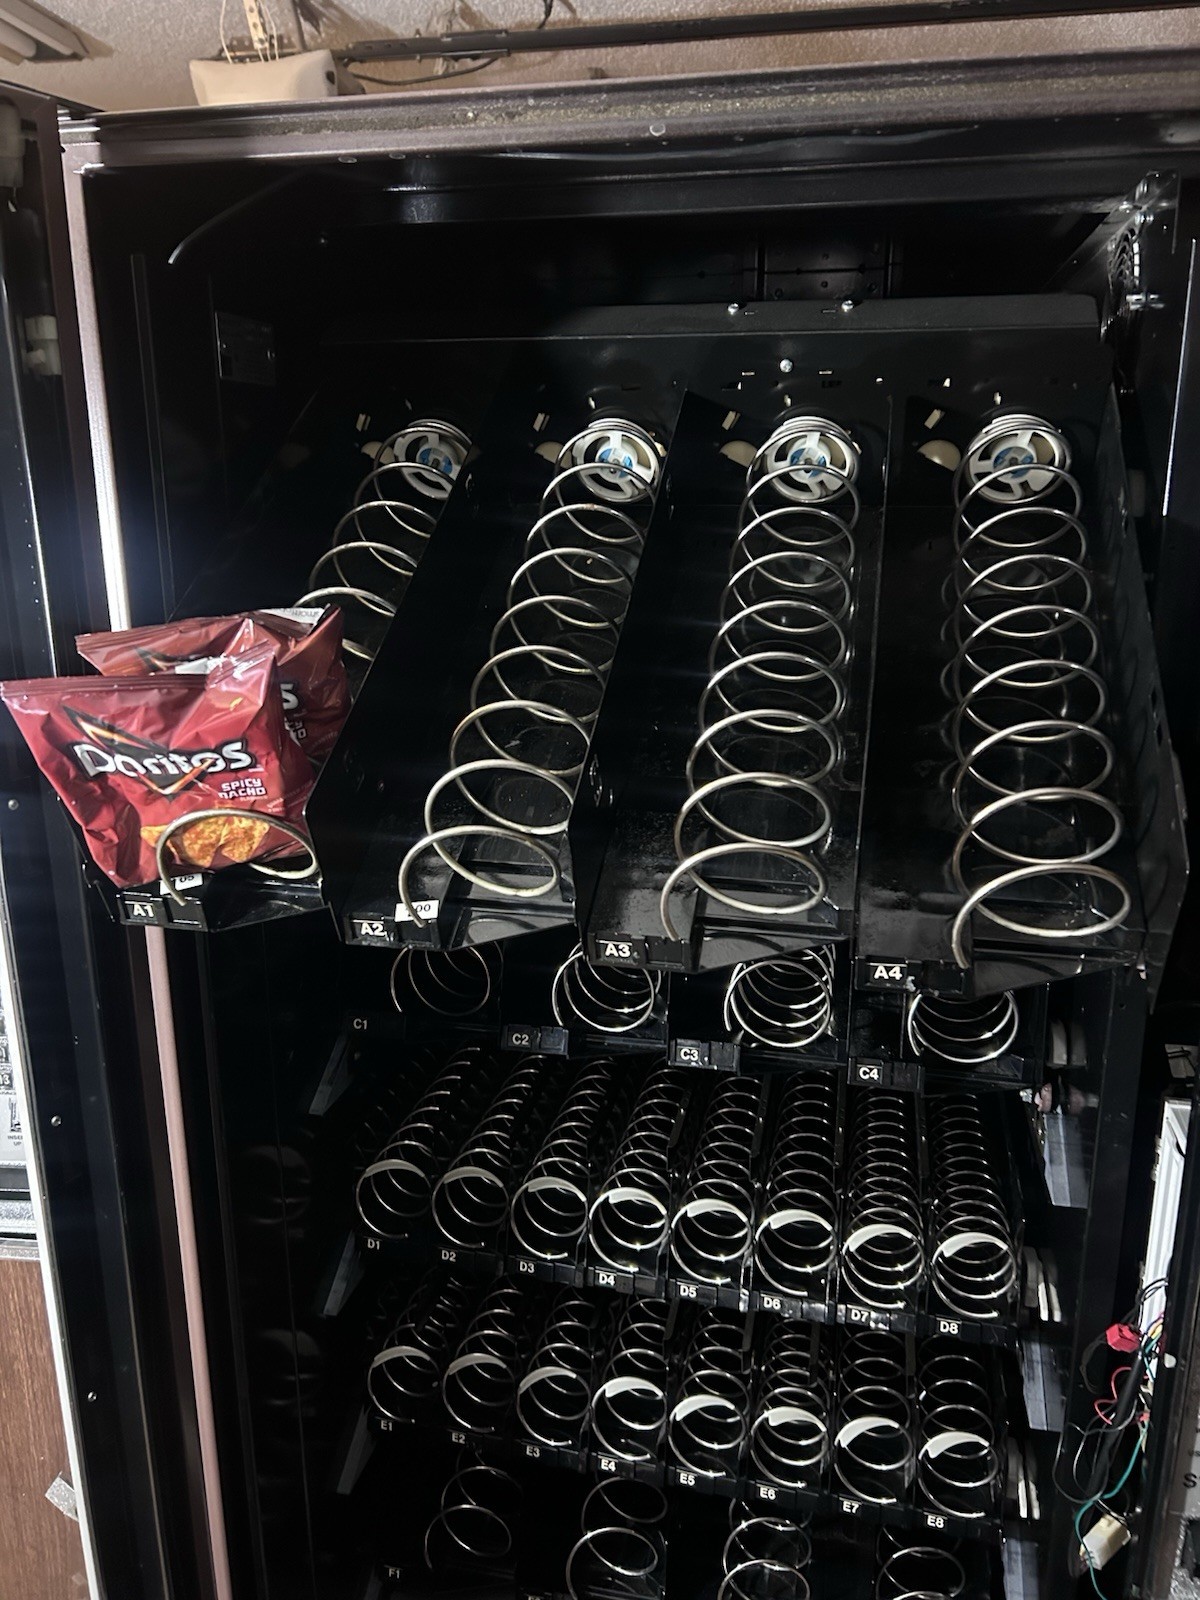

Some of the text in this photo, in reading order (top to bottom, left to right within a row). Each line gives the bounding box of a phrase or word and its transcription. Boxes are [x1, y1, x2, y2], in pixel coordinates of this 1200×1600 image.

[73, 742, 251, 778] Doritos
[221, 778, 262, 792] SPICY
[218, 787, 267, 799] NACHO
[133, 904, 154, 917] A1
[361, 922, 386, 936] A2
[605, 944, 630, 957] A3
[874, 965, 902, 980] A4
[353, 1018, 368, 1031] C1
[512, 1033, 530, 1045] C2
[680, 1048, 699, 1062] C3
[859, 1067, 879, 1080] C4
[367, 1239, 380, 1250] D1
[441, 1251, 456, 1262] D2
[519, 1262, 535, 1273] D3
[599, 1273, 615, 1286] D4
[679, 1284, 697, 1297] D5
[763, 1297, 781, 1310] D6
[851, 1309, 869, 1322] D7
[939, 1321, 958, 1334] D8
[380, 1421, 393, 1432] E1
[451, 1432, 465, 1444] E2
[526, 1446, 540, 1458] E3
[601, 1459, 616, 1471] E4
[679, 1473, 695, 1486] E5
[759, 1487, 776, 1500] E6
[843, 1501, 860, 1513] E7
[927, 1515, 944, 1529] E8
[388, 1567, 400, 1579] F1
